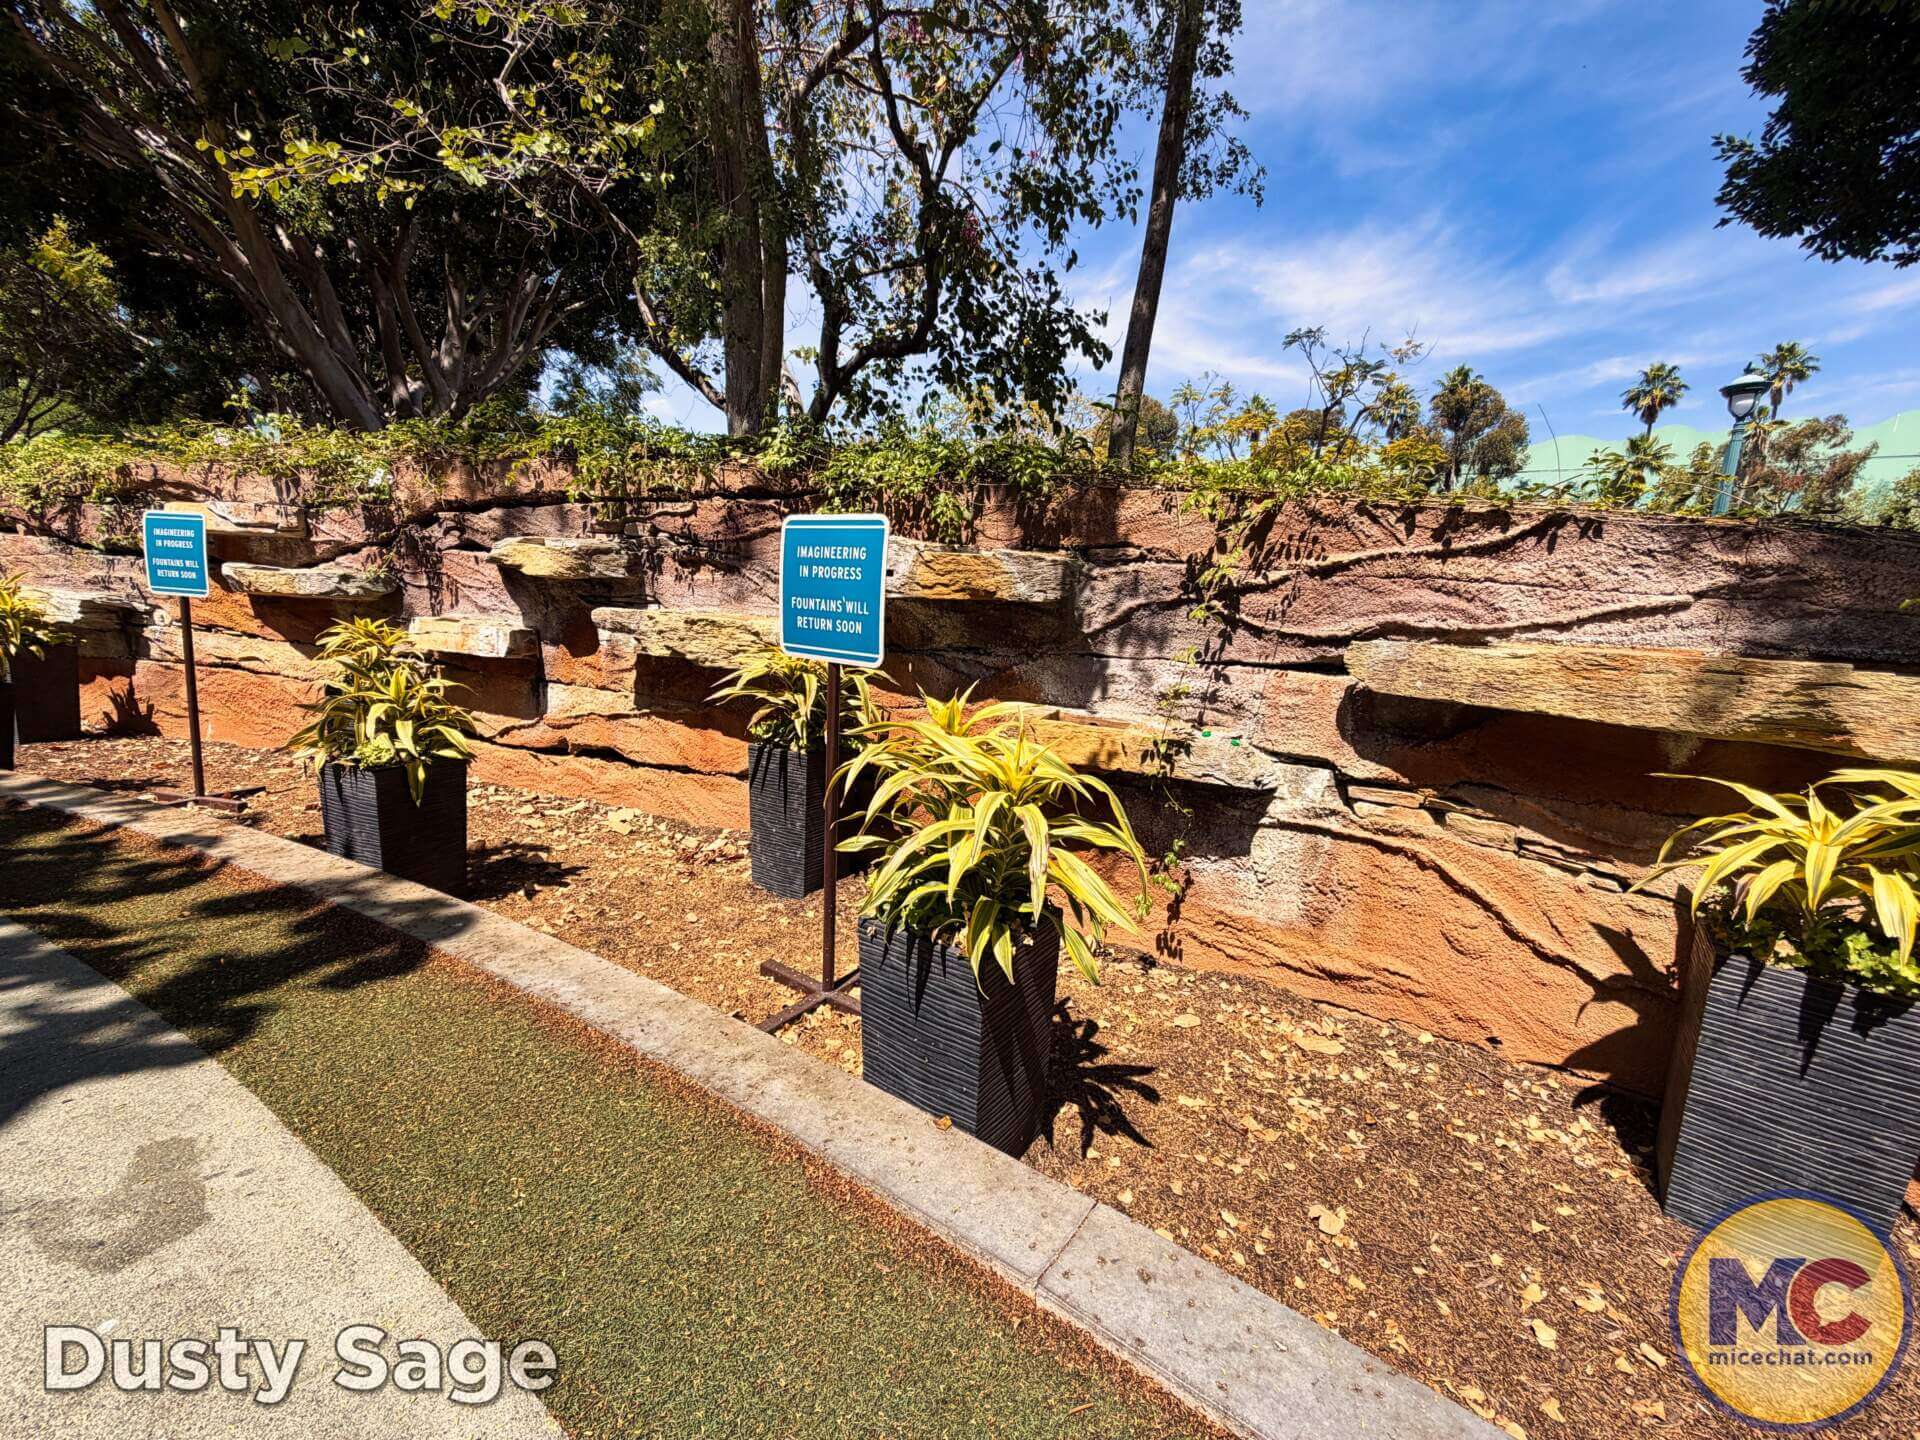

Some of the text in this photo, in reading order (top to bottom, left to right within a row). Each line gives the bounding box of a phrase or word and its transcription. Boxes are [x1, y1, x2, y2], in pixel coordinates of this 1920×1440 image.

[153, 528, 195, 538] IMAGINEERING
[155, 539, 193, 549] IN PROGRESS
[797, 545, 867, 560] IMAGINEERING
[152, 558, 199, 568] FOUNTAINS WILL
[157, 569, 197, 579] RETURN SOON
[799, 565, 862, 580] IN PROGRESS
[791, 596, 869, 615] FOUNTAINS WILL
[797, 616, 862, 634] RETURN SOON
